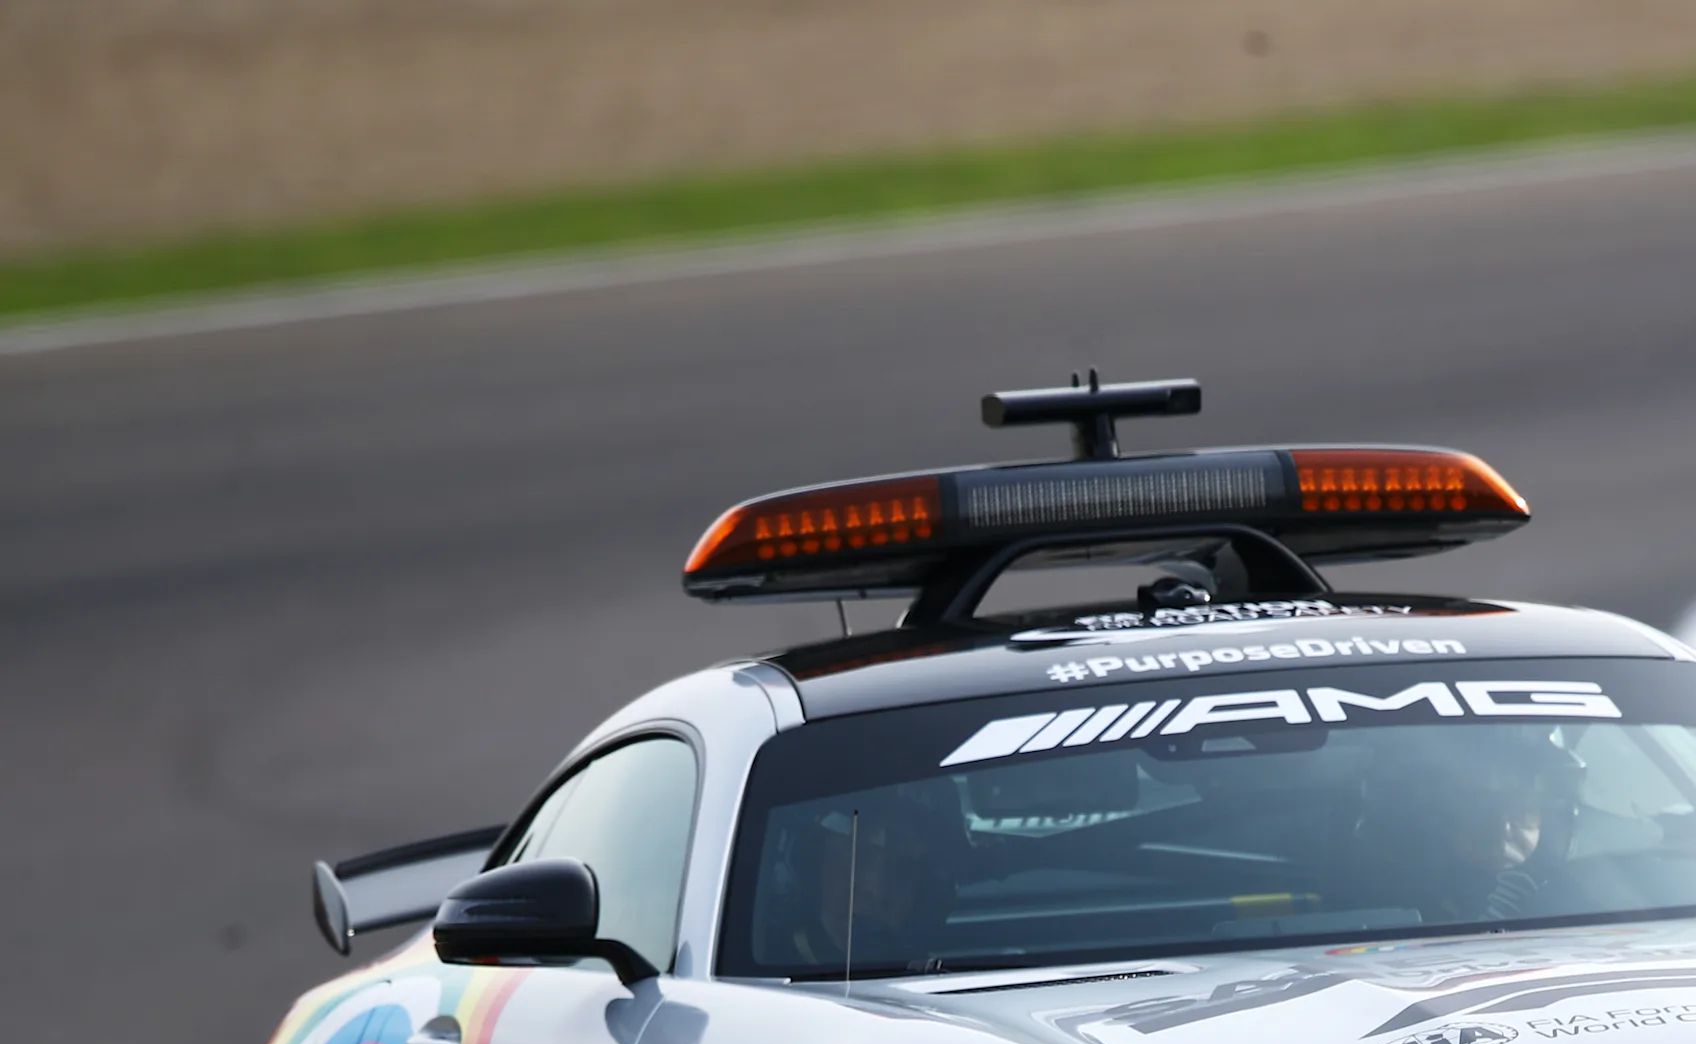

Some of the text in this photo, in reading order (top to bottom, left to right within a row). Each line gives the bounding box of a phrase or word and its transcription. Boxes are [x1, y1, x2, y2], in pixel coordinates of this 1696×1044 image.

[1047, 635, 1467, 682] #PurposeDriven
[1160, 681, 1622, 735] AMG
[1526, 1014, 1599, 1029] FIA
[1535, 1012, 1668, 1039] World
